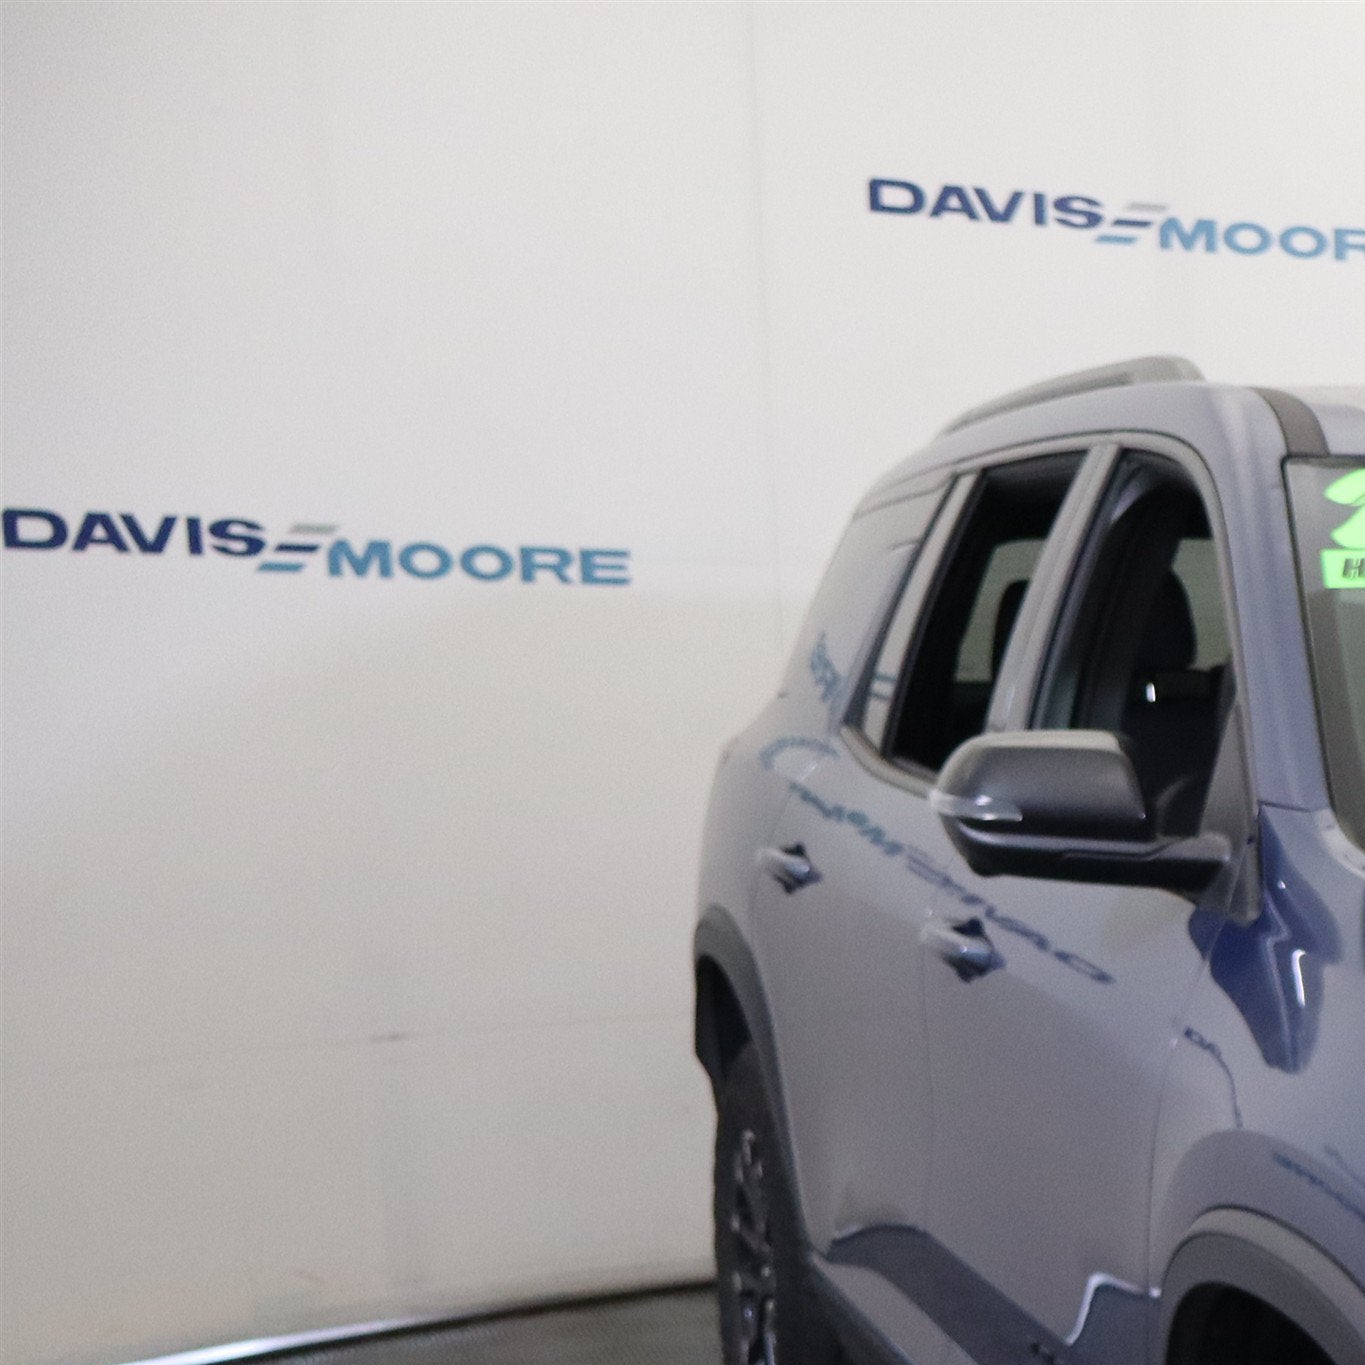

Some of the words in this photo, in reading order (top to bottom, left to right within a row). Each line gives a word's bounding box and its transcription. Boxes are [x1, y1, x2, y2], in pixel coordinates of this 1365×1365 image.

[865, 176, 1106, 231] DAVIS
[0, 506, 269, 560] DAVIS
[326, 537, 631, 587] MOORE
